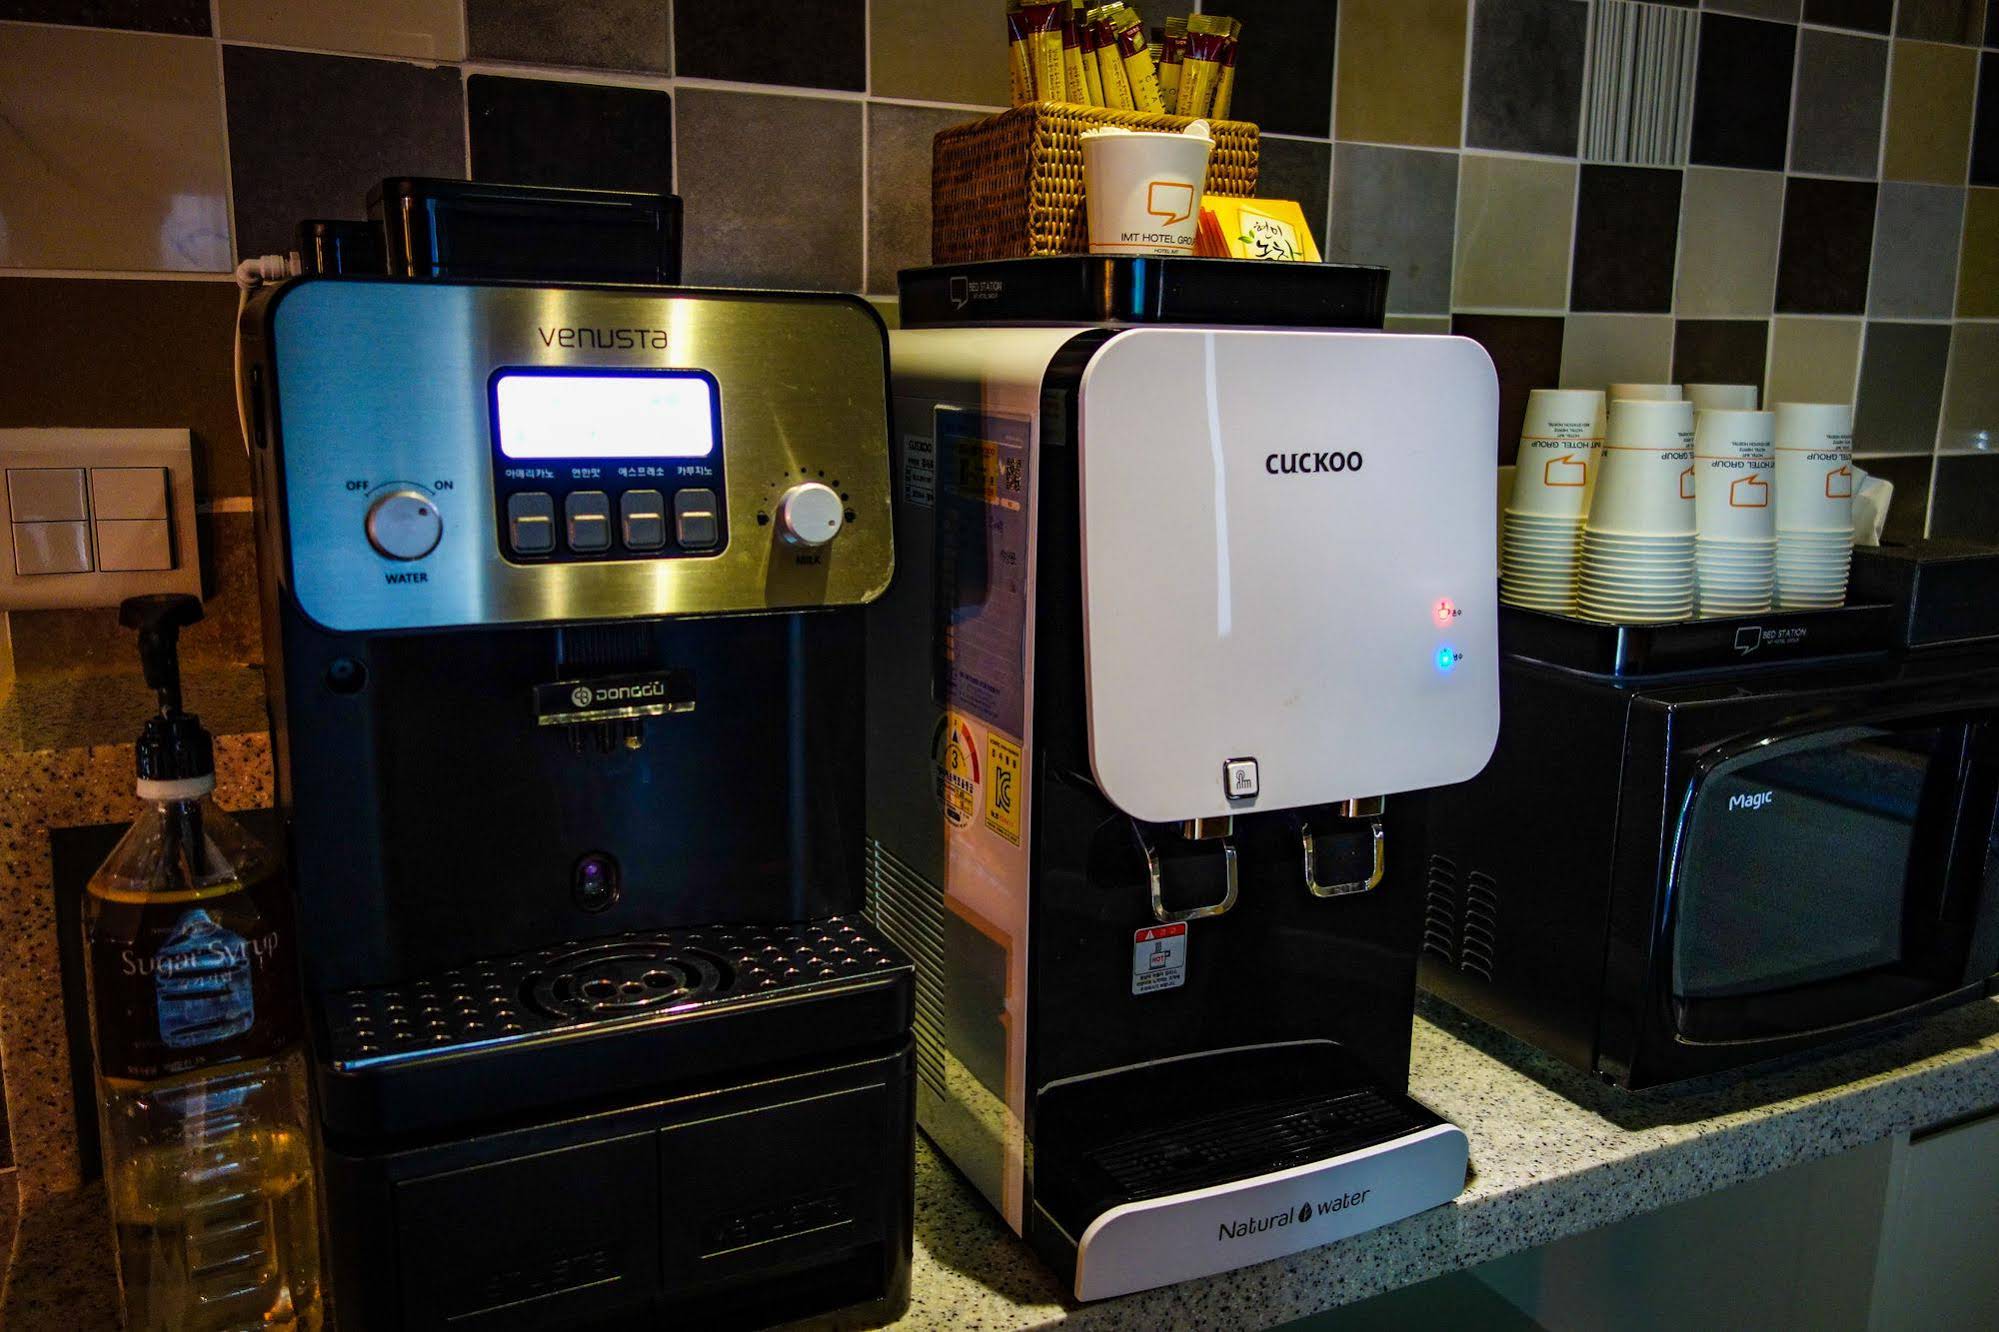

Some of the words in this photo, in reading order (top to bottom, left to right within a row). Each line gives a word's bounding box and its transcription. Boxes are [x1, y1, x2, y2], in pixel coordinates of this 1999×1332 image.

[1253, 221, 1283, 239] 현미
[1121, 233, 1140, 242] IMT
[1142, 233, 1175, 243] HOTEL
[1531, 441, 1559, 449] GROUP
[1561, 441, 1589, 449] HOTEL
[1661, 452, 1688, 460] GROUP
[1806, 453, 1838, 461] GROUP
[1265, 451, 1363, 475] CUCKOO
[1711, 460, 1745, 469] GROUP
[1747, 461, 1770, 469] HOTEL
[505, 468, 555, 479] 아메리카노
[618, 466, 665, 477] 에스프레소
[677, 466, 713, 476] 카푸치노
[346, 480, 369, 491] OFF
[434, 480, 454, 490] ON
[385, 572, 428, 584] WATER
[1728, 790, 1773, 811] Magic
[121, 949, 198, 978] Sugar
[207, 930, 279, 965] Syrup
[1218, 1206, 1294, 1241] Natural
[1317, 1189, 1371, 1216] water
